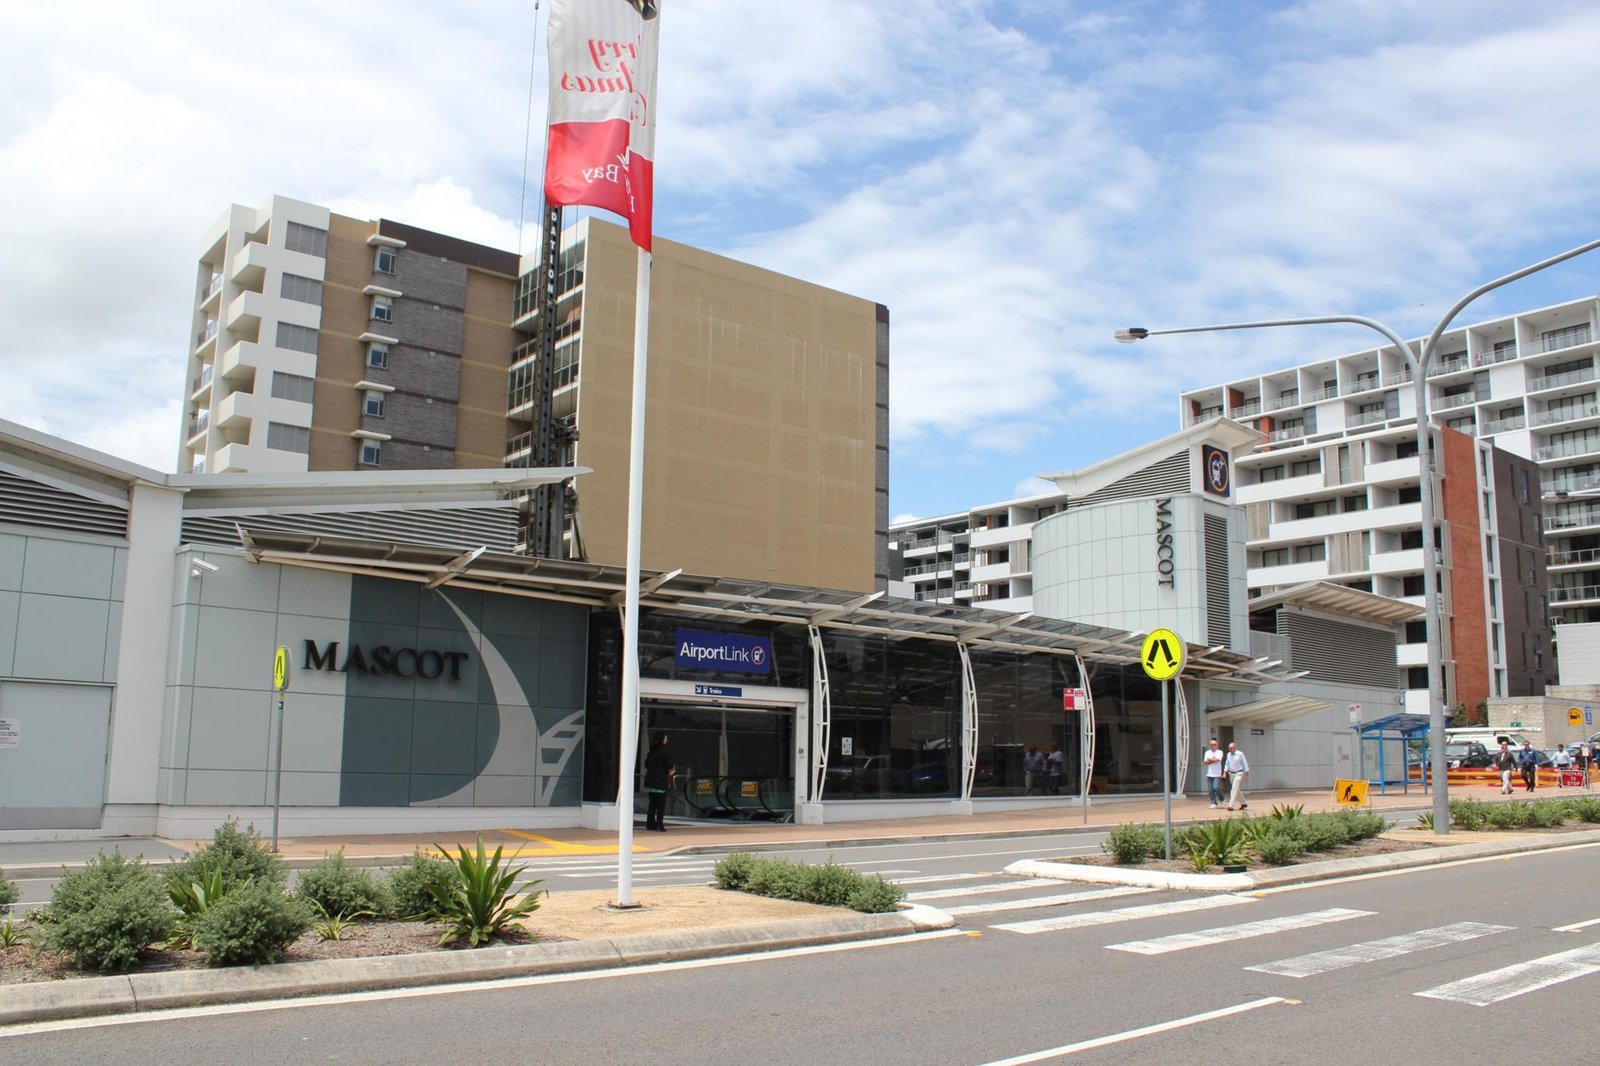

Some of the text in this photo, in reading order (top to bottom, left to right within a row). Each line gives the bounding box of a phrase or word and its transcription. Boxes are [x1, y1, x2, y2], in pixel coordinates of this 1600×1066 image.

[1156, 497, 1175, 590] MASCOT
[301, 639, 469, 681] MASCOT
[680, 642, 749, 662] AirportLink
